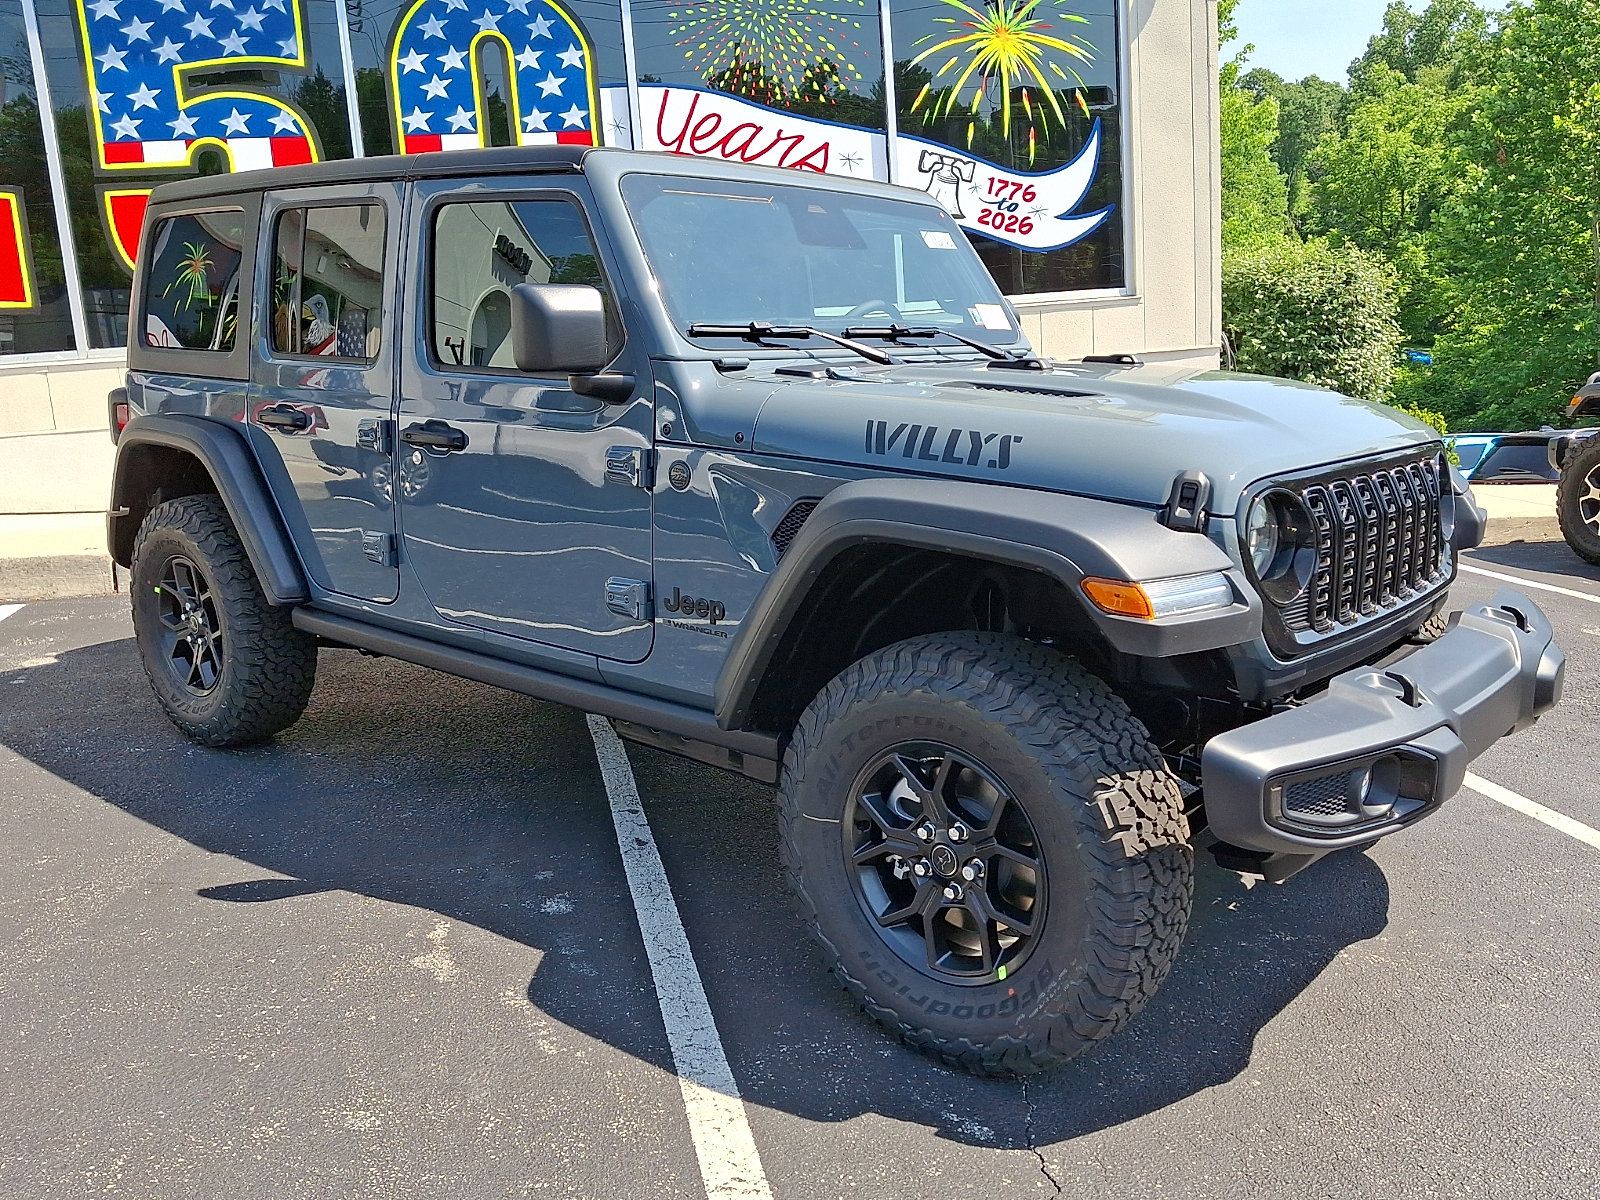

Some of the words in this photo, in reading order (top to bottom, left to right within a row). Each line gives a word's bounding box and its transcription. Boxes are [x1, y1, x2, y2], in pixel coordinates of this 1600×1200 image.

[656, 89, 830, 174] Years
[984, 197, 1019, 212] to
[988, 177, 1037, 202] 1776
[977, 208, 1034, 235] 2026
[865, 419, 1023, 470] WILLYS
[664, 587, 725, 625] Jeep
[672, 620, 728, 639] WRANGLER
[857, 951, 1054, 1020] BFGoodrich
